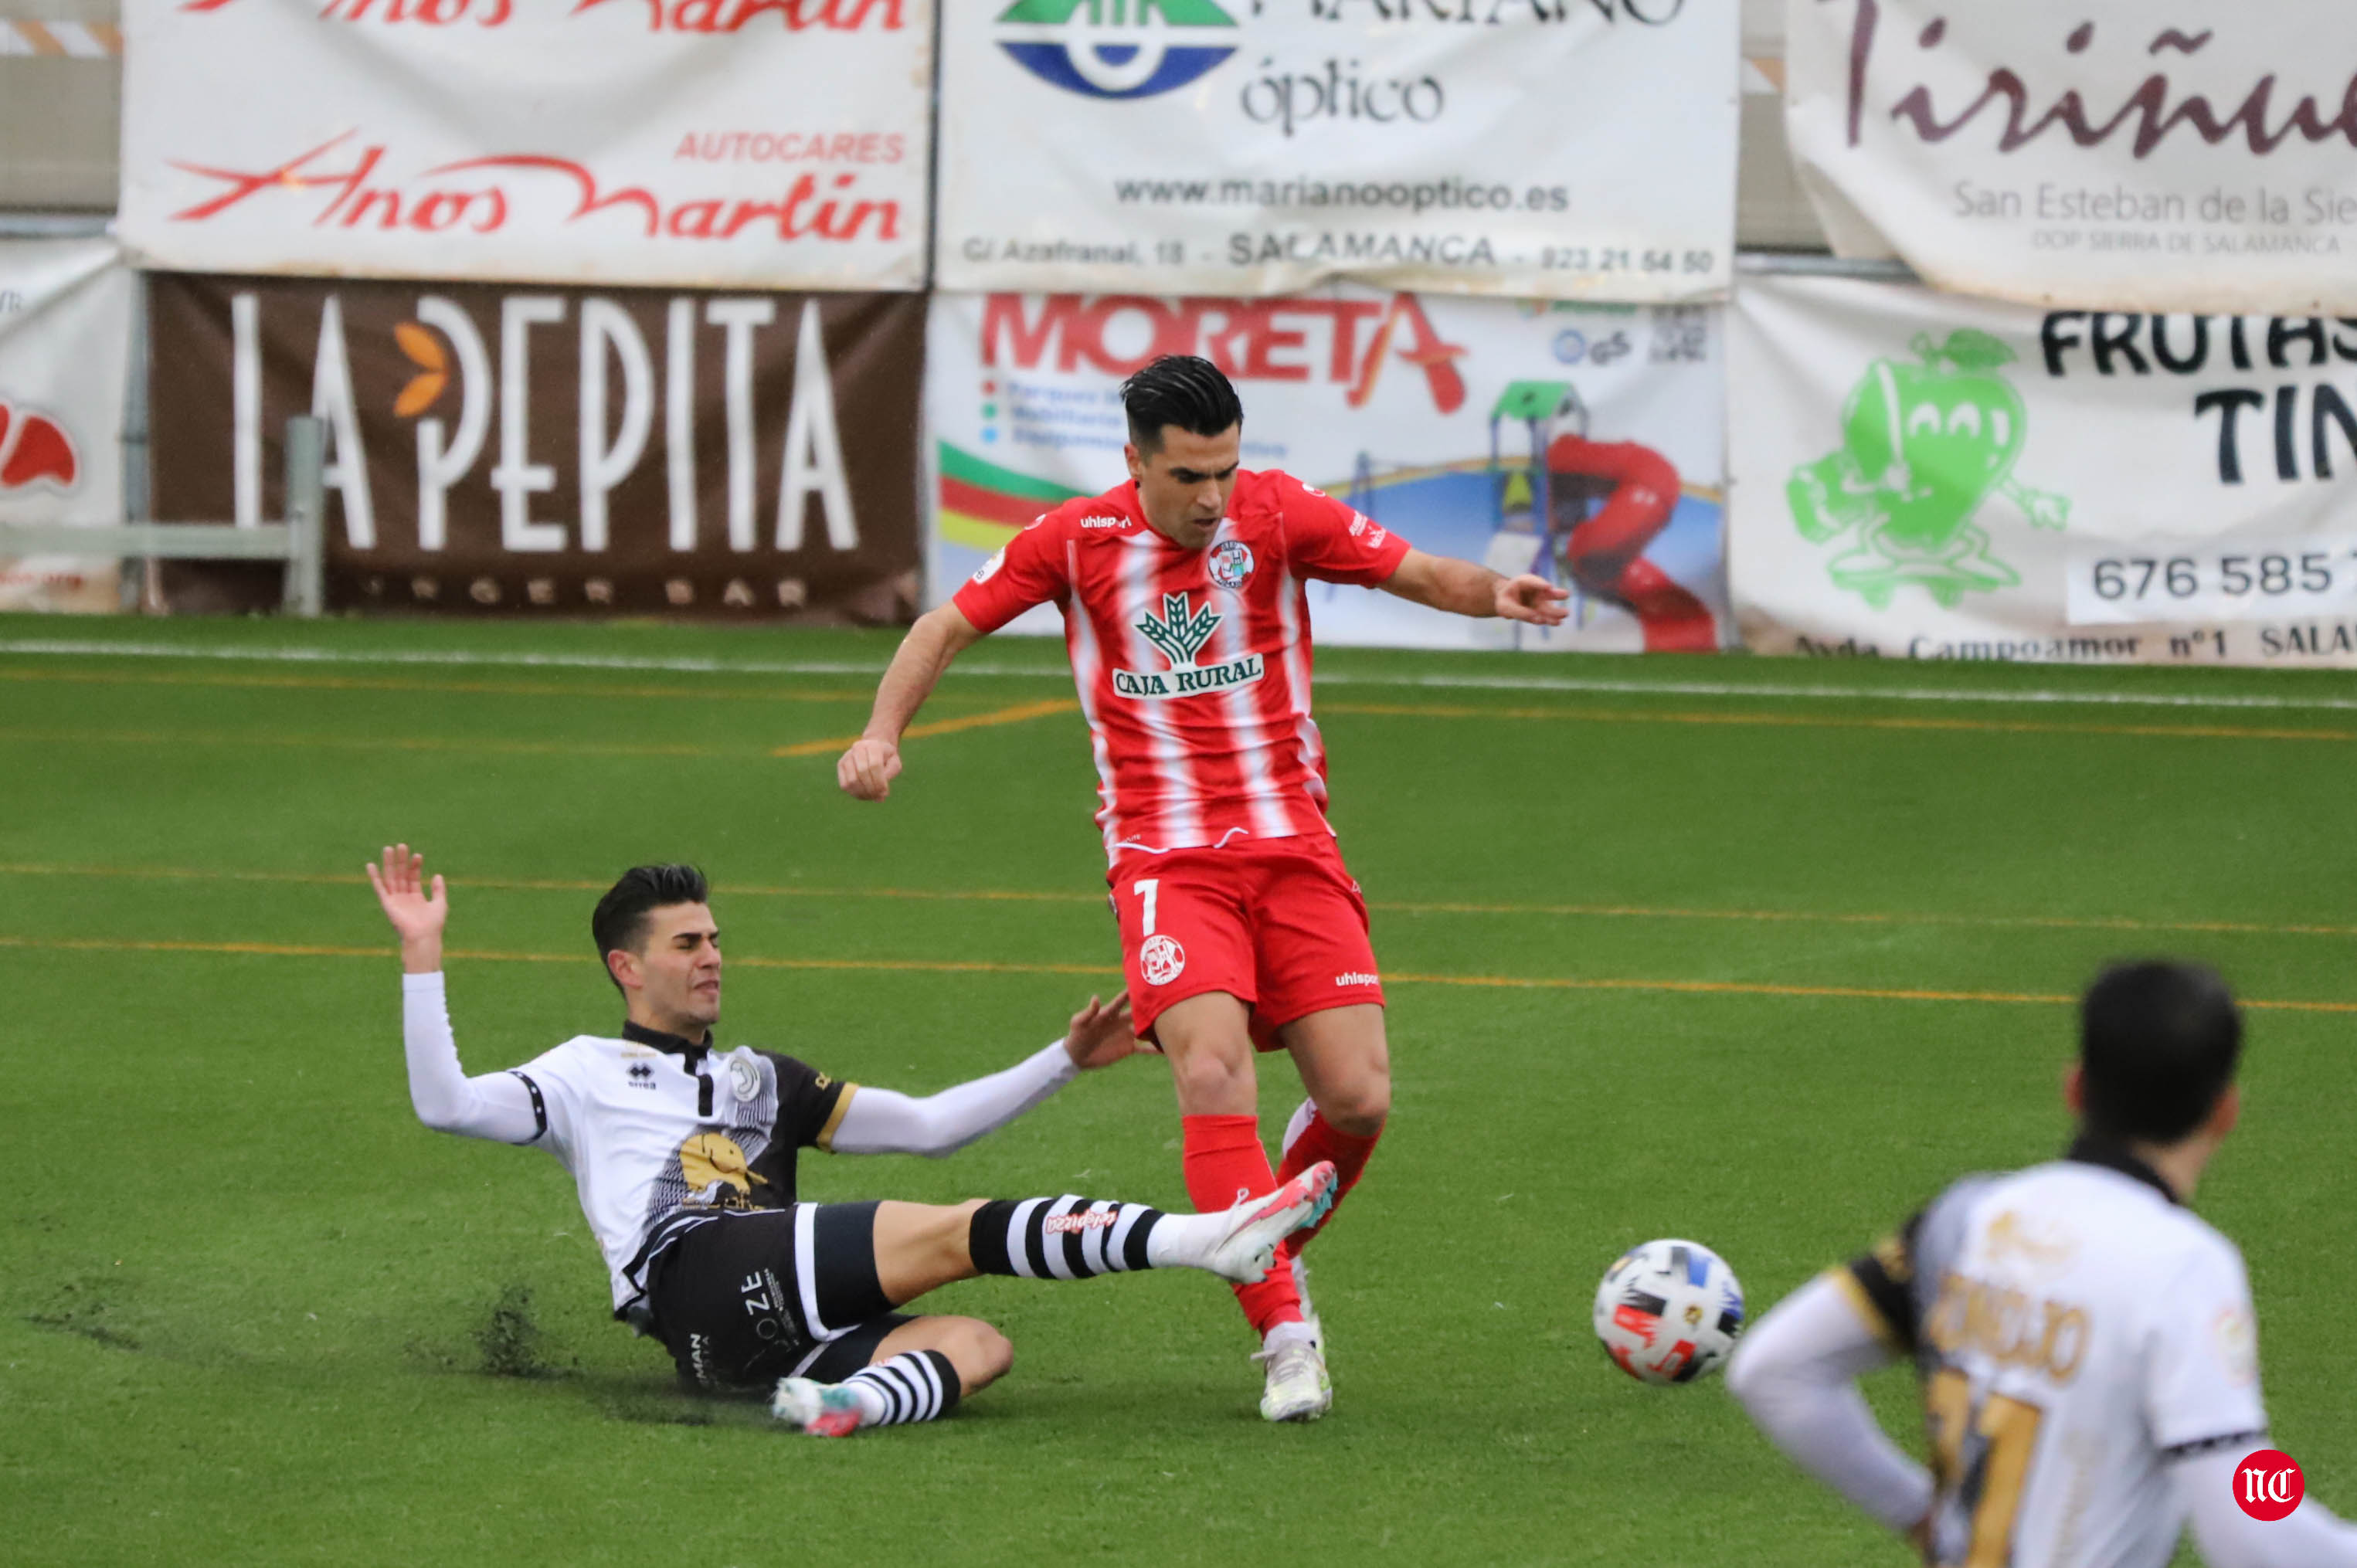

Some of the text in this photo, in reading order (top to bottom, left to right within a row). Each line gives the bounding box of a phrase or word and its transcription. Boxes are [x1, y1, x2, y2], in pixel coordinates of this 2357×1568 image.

[1240, 56, 1444, 137] óptico
[674, 133, 905, 164] AUTOCARES
[162, 127, 508, 233] Anos
[1115, 176, 1569, 213] www.marianooptico.es
[1953, 180, 2022, 219] San
[2037, 182, 2186, 224] Esteban
[2198, 185, 2247, 226] de
[2258, 186, 2291, 226] la
[1228, 232, 1496, 266] SALAMANCA
[417, 294, 859, 552] PEPITA
[2093, 555, 2333, 600] 676 585
[2259, 625, 2357, 657] SALA
[1116, 657, 1262, 696] CAJA RURAL
